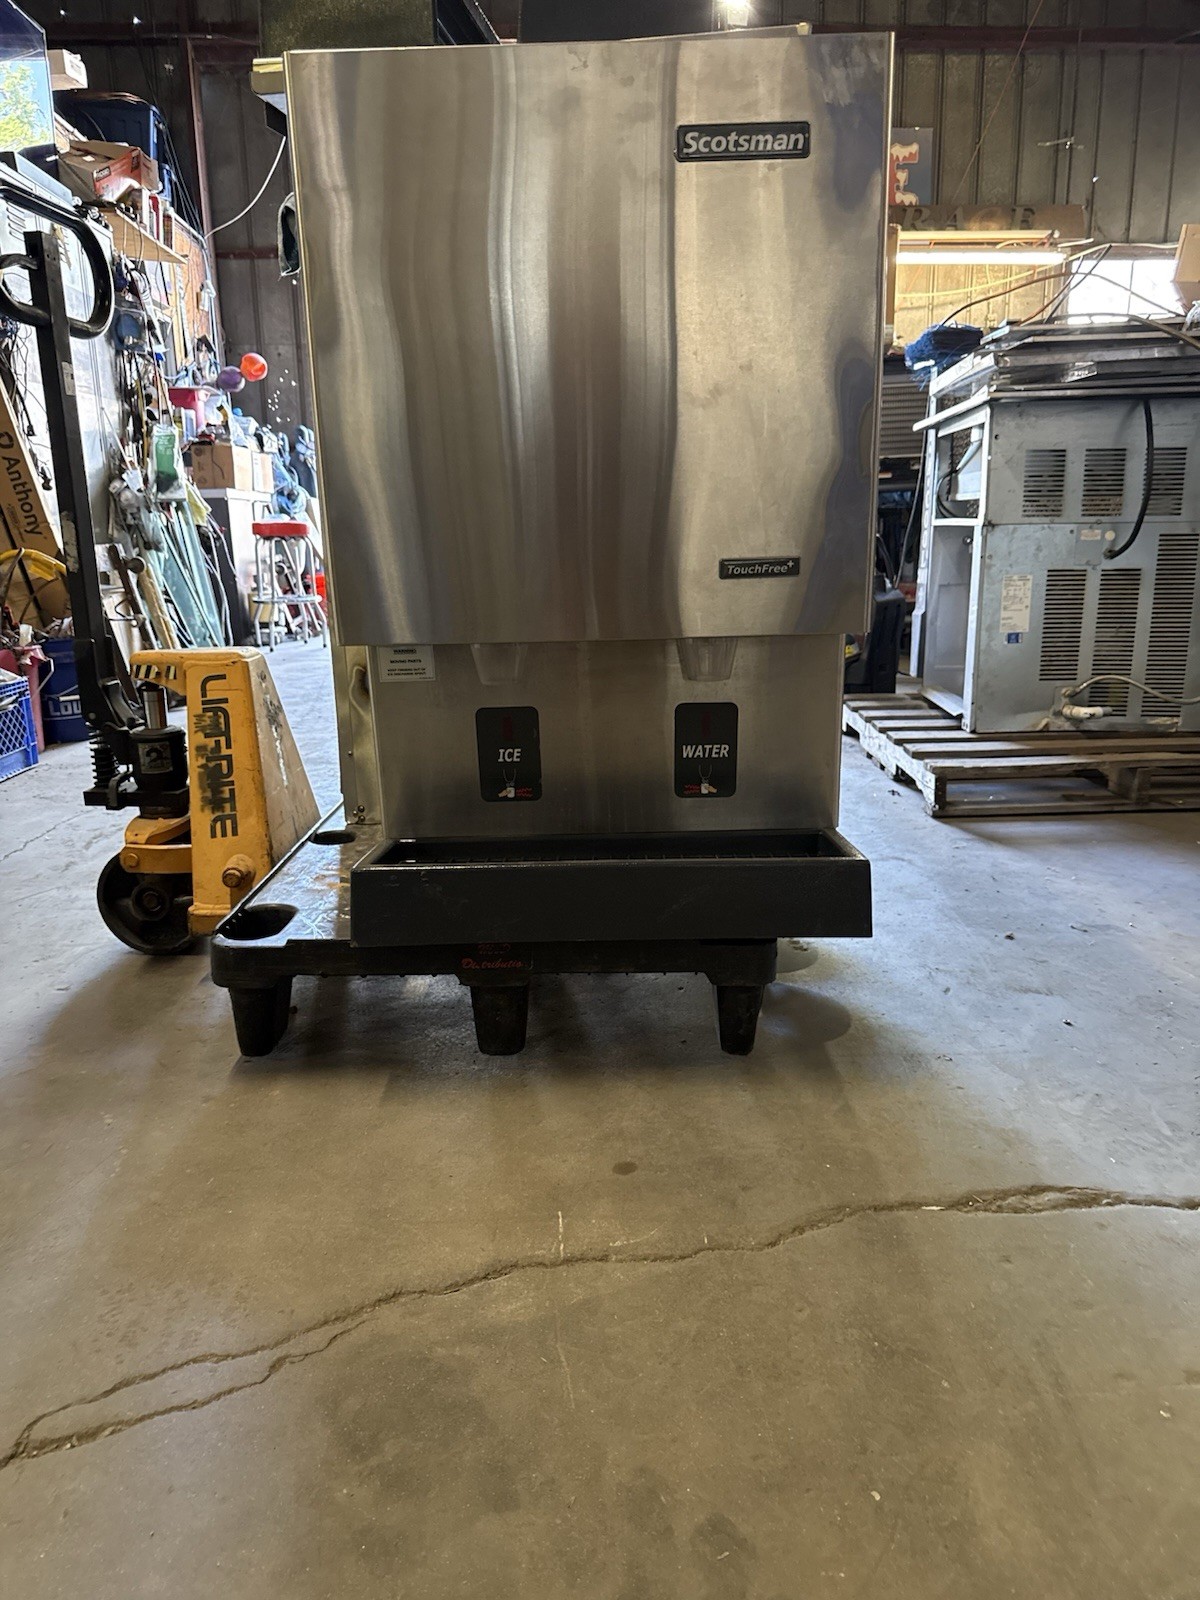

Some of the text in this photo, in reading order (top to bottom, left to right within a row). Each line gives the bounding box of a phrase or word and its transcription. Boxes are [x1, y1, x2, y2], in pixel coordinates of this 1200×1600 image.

[682, 131, 805, 154] Scotsman
[1, 456, 43, 536] Anthony
[497, 748, 522, 762] ICE
[682, 744, 730, 759] WATER
